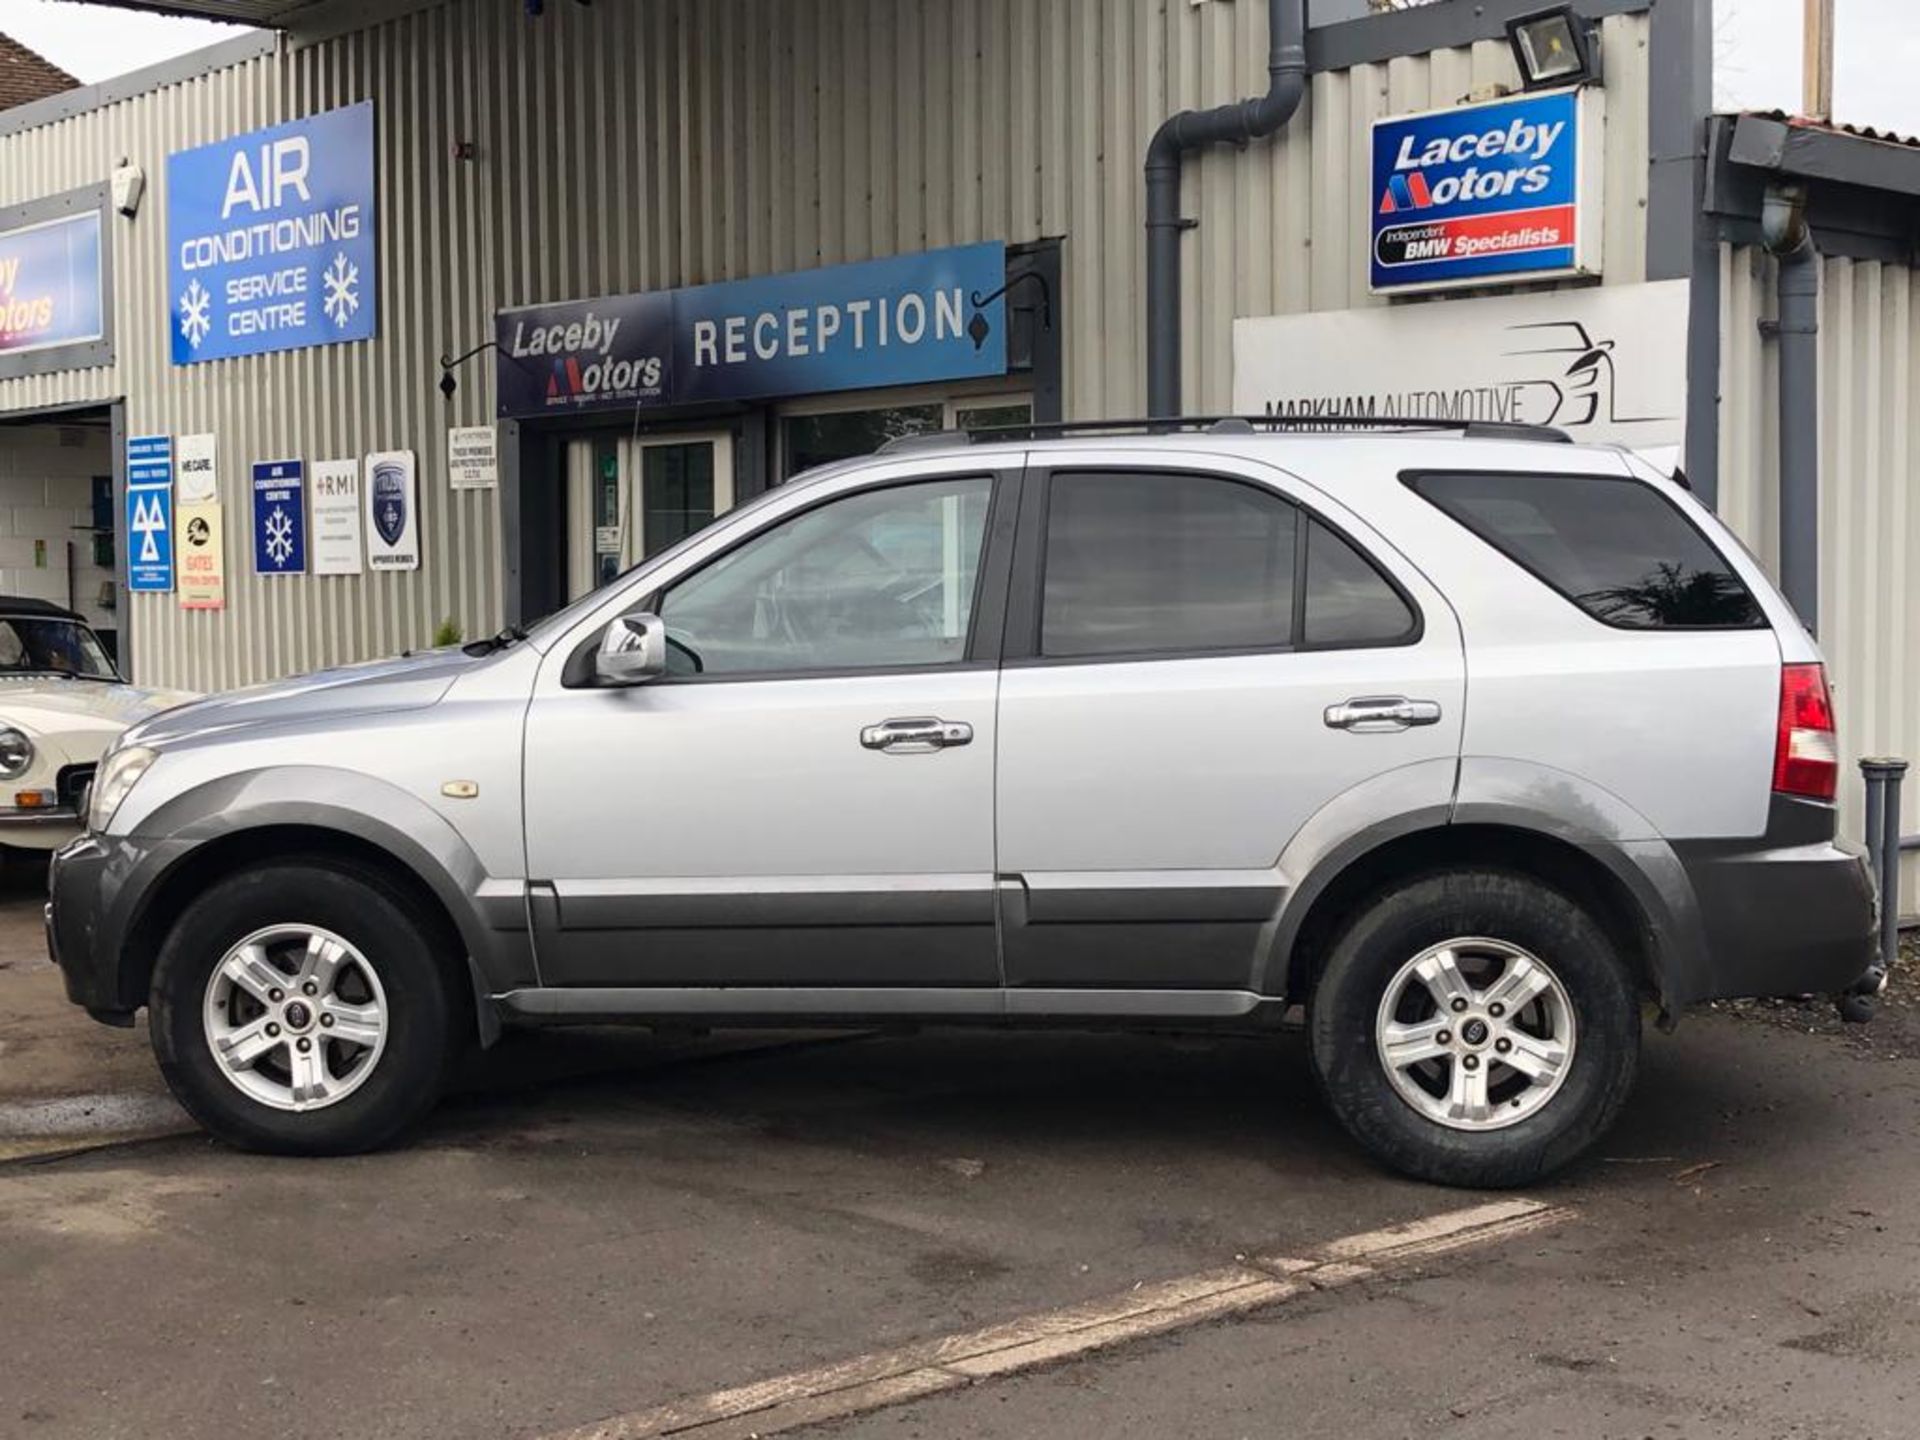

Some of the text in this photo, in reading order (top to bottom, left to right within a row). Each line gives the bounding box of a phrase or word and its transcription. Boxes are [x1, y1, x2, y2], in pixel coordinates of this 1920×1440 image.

[1394, 118, 1566, 170] Laceby
[221, 135, 311, 219] AIR
[1379, 164, 1552, 214] Motors
[181, 205, 359, 271] CONDITIONING
[1386, 225, 1447, 243] Independent
[1404, 227, 1560, 260] BMW Specialists
[226, 267, 307, 305] SERVICE
[228, 301, 306, 336] CENTRE
[512, 313, 620, 358] Laceby
[694, 288, 963, 366] RECEPTION
[546, 356, 662, 396] Motors
